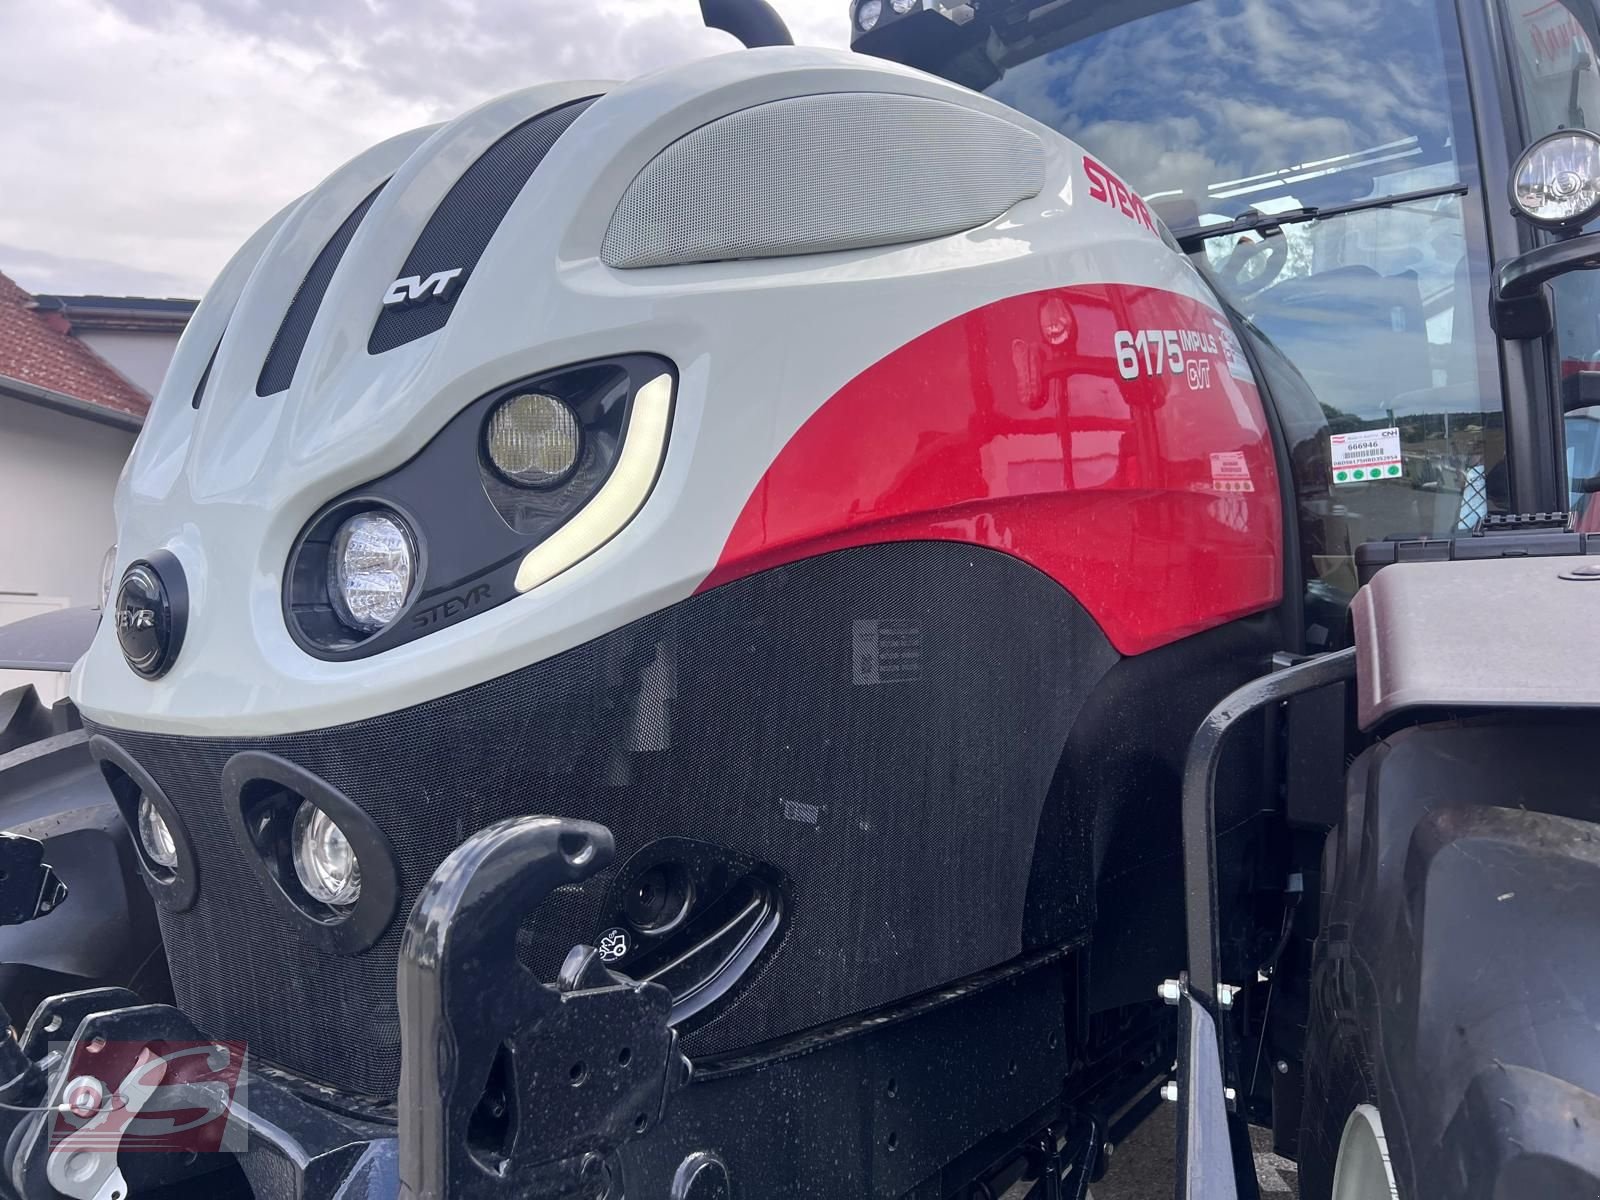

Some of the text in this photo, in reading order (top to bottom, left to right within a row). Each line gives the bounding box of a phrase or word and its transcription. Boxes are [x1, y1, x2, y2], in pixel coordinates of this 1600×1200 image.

[1082, 155, 1161, 240] STEYR
[382, 267, 463, 305] CVT
[1114, 329, 1185, 381] 6175
[1178, 329, 1219, 355] IMPULS
[1348, 441, 1378, 451] 666946
[1381, 429, 1398, 437] CNH
[410, 583, 492, 630] STEYR
